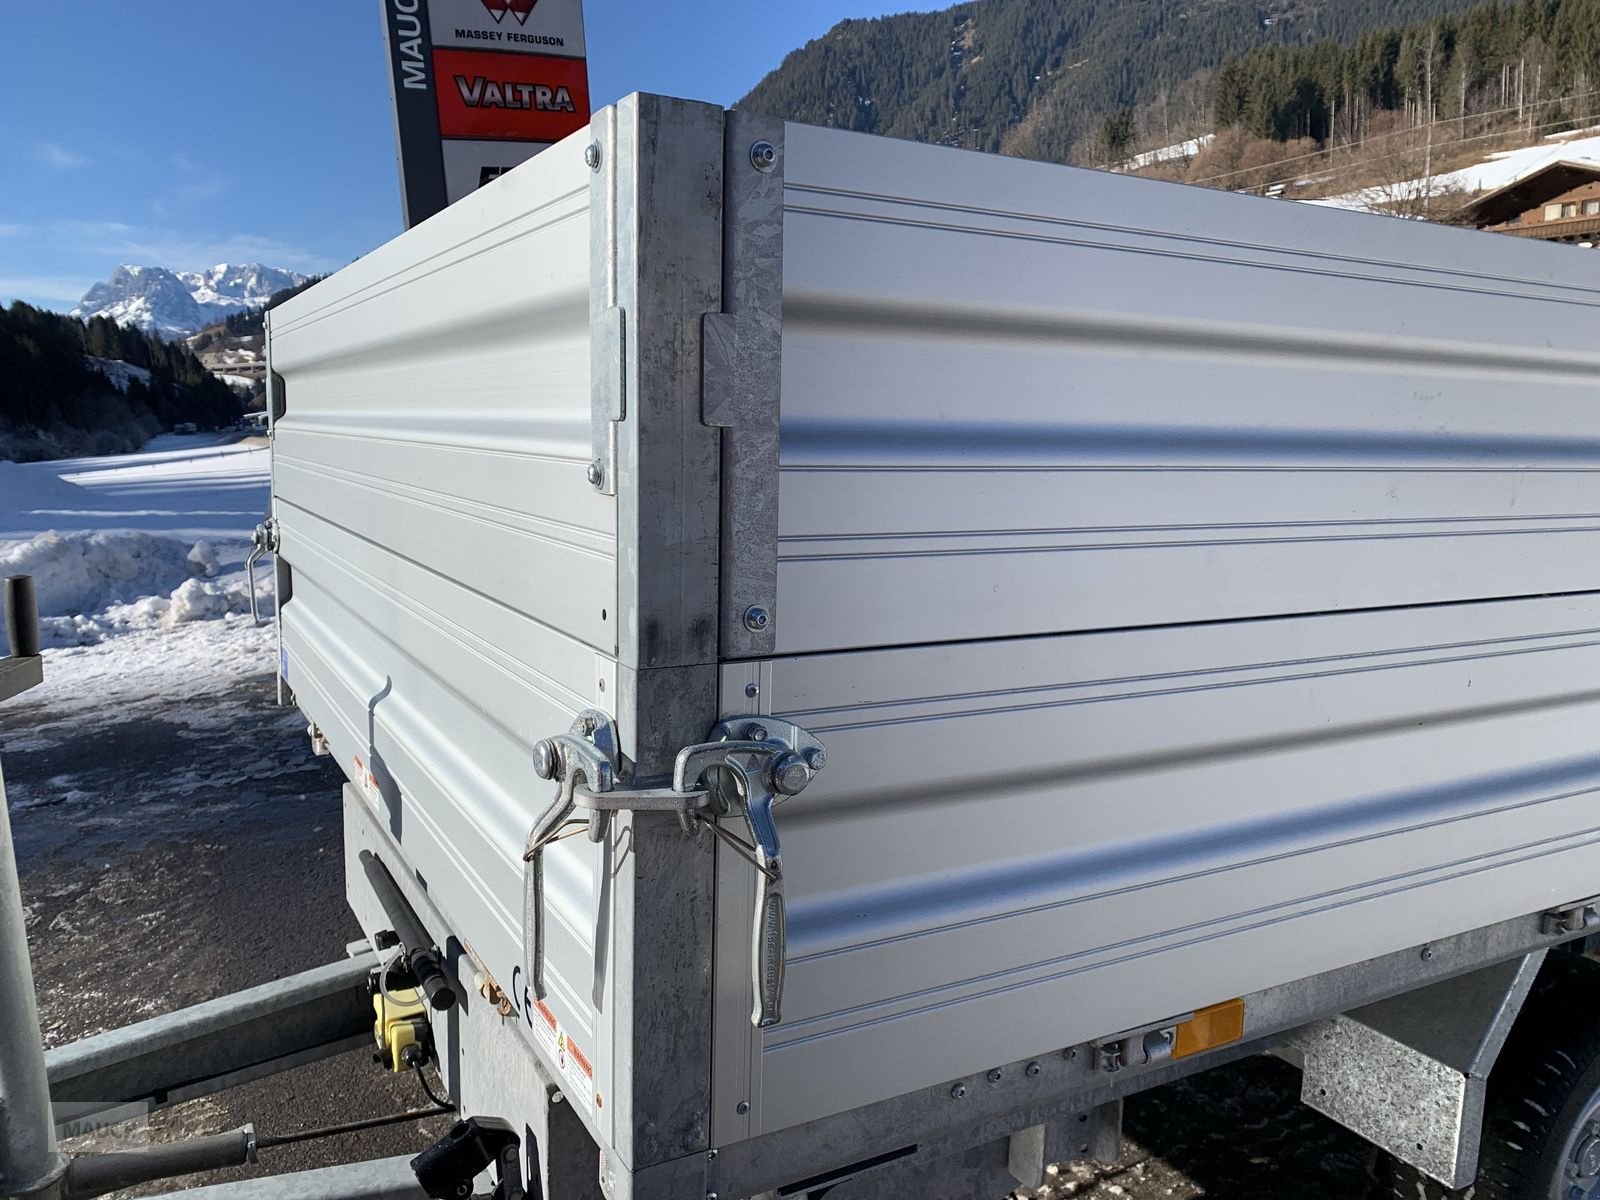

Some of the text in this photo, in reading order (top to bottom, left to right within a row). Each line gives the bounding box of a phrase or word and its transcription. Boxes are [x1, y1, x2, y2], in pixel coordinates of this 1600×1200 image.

[455, 28, 564, 46] MASSEY FERGUSON
[453, 75, 576, 113] VALTRA
